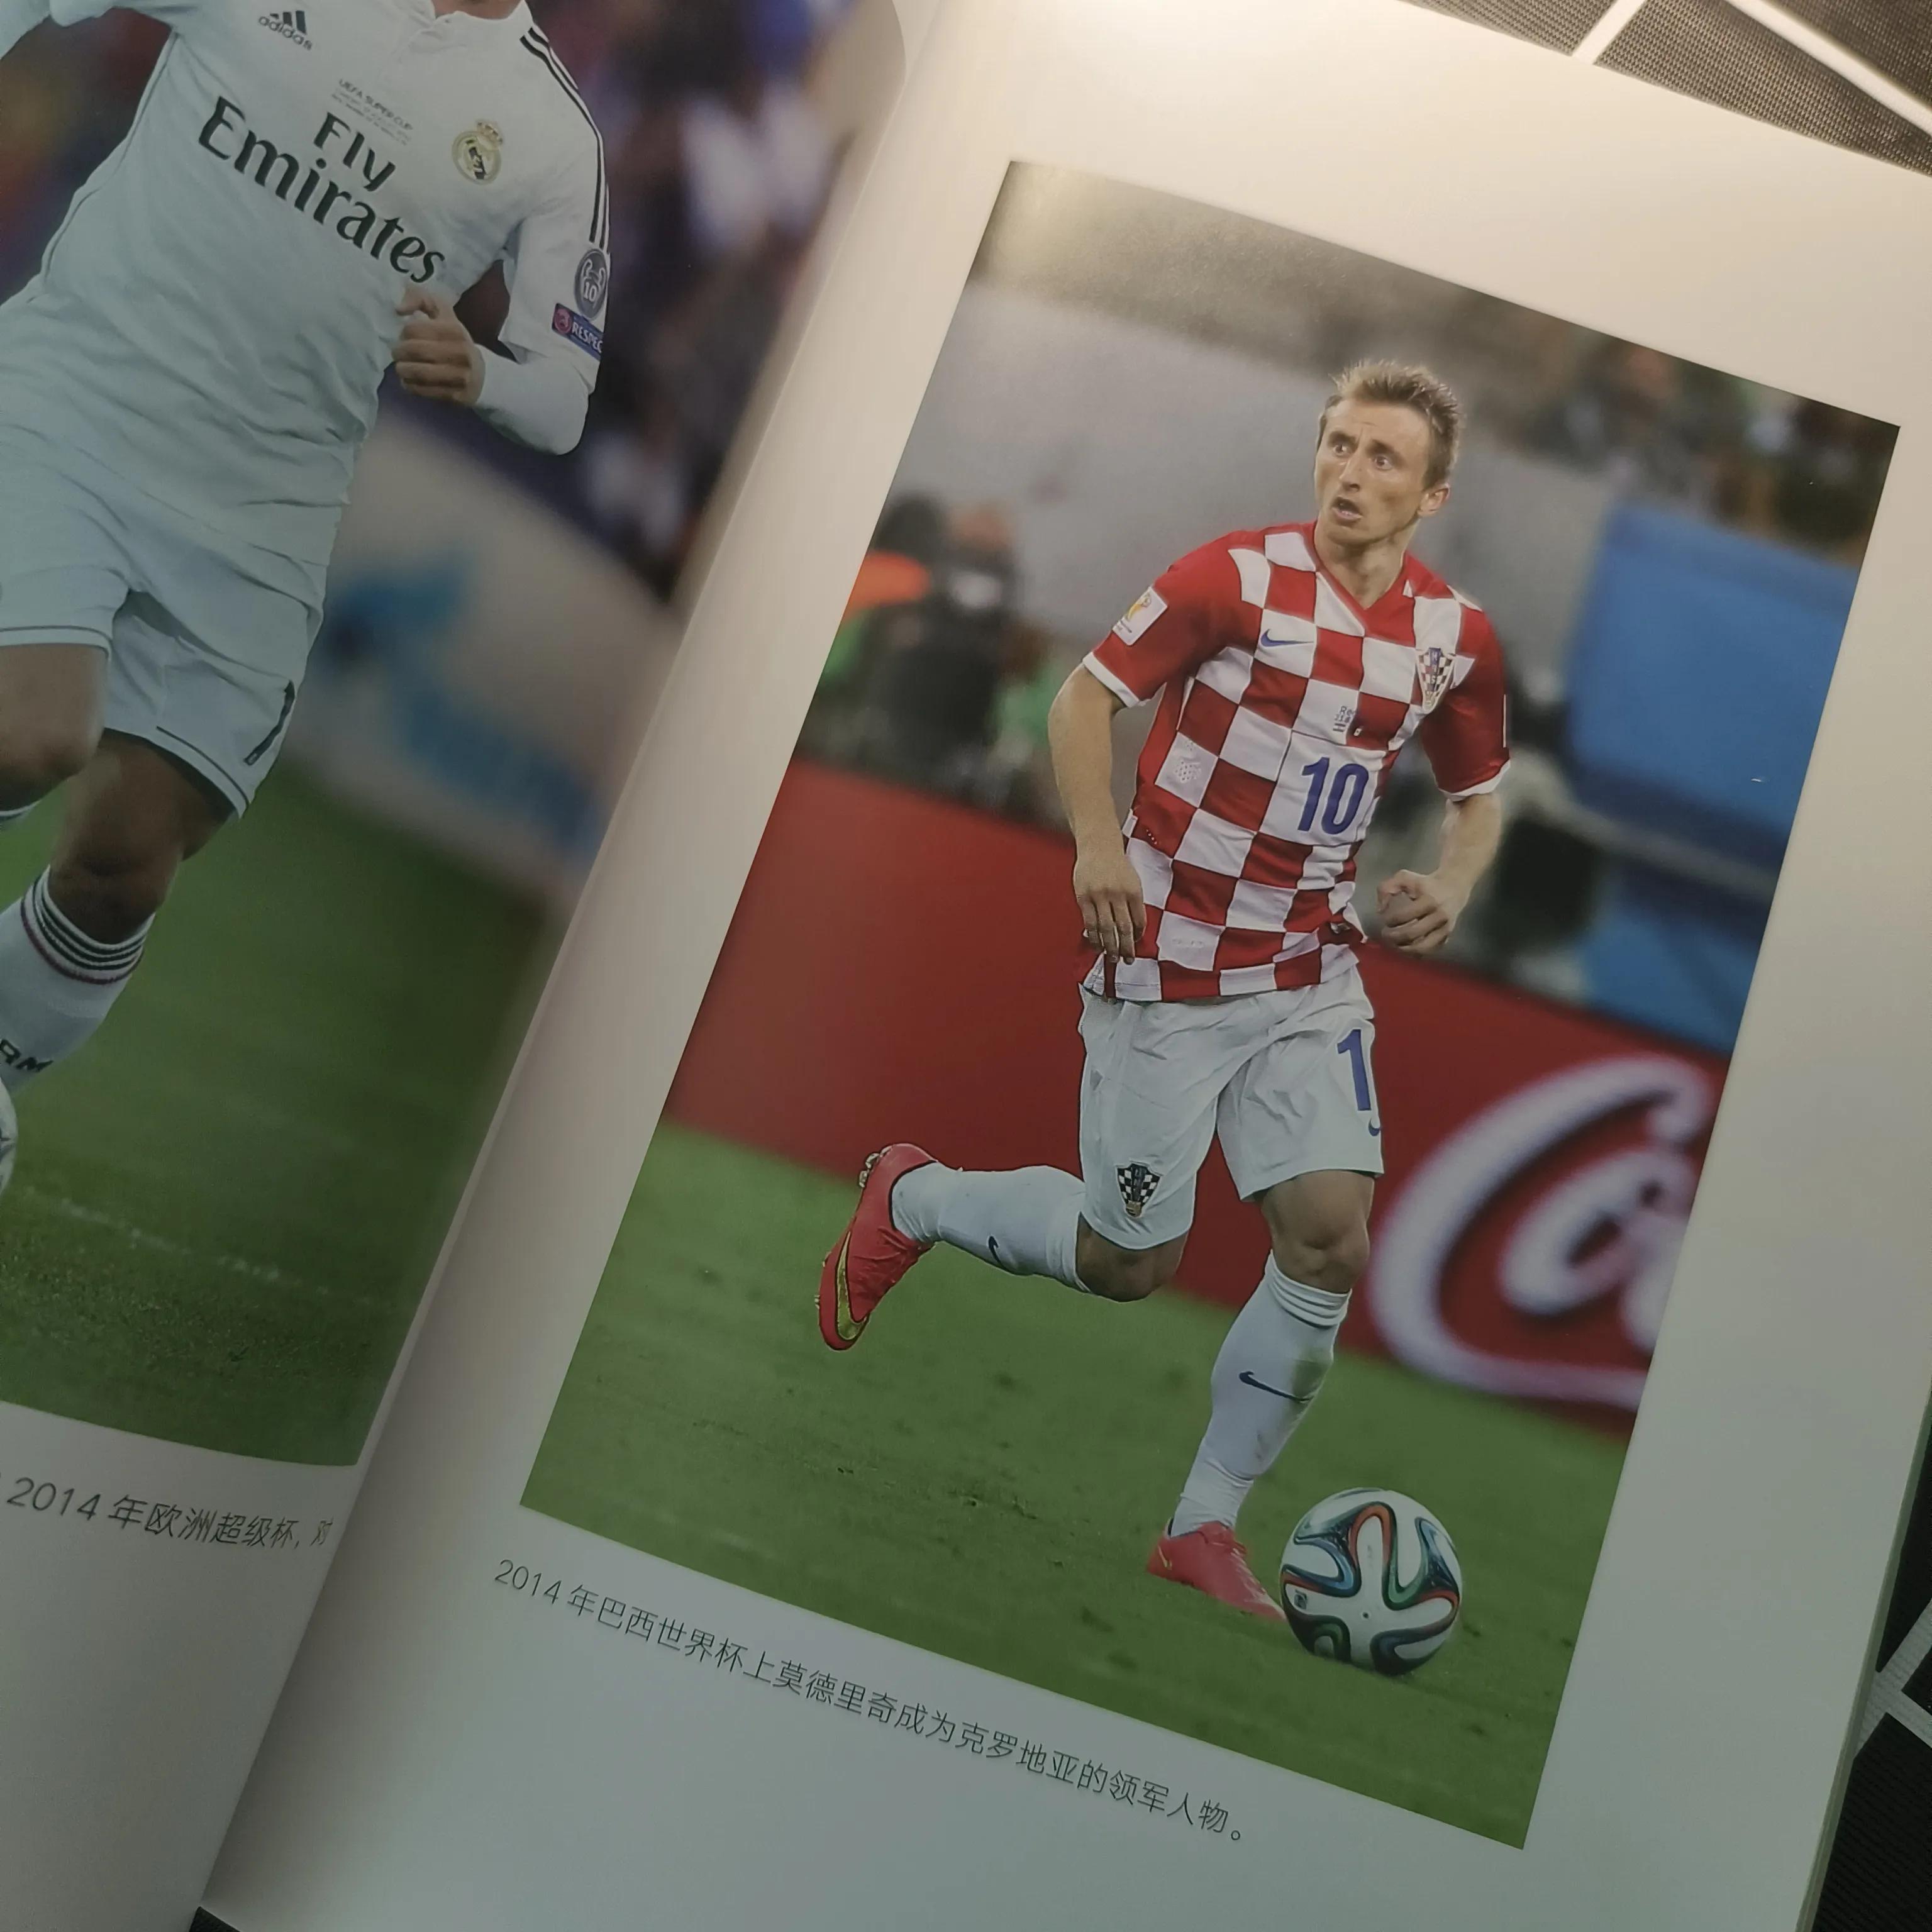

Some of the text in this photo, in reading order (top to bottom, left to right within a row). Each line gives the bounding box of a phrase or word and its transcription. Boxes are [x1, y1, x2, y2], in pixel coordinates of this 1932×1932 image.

[258, 16, 313, 50] adidas
[199, 96, 445, 284] Emirates
[314, 112, 396, 191] Fly
[583, 282, 597, 303] 10
[1297, 757, 1368, 834] 10
[1337, 1029, 1372, 1111] 1
